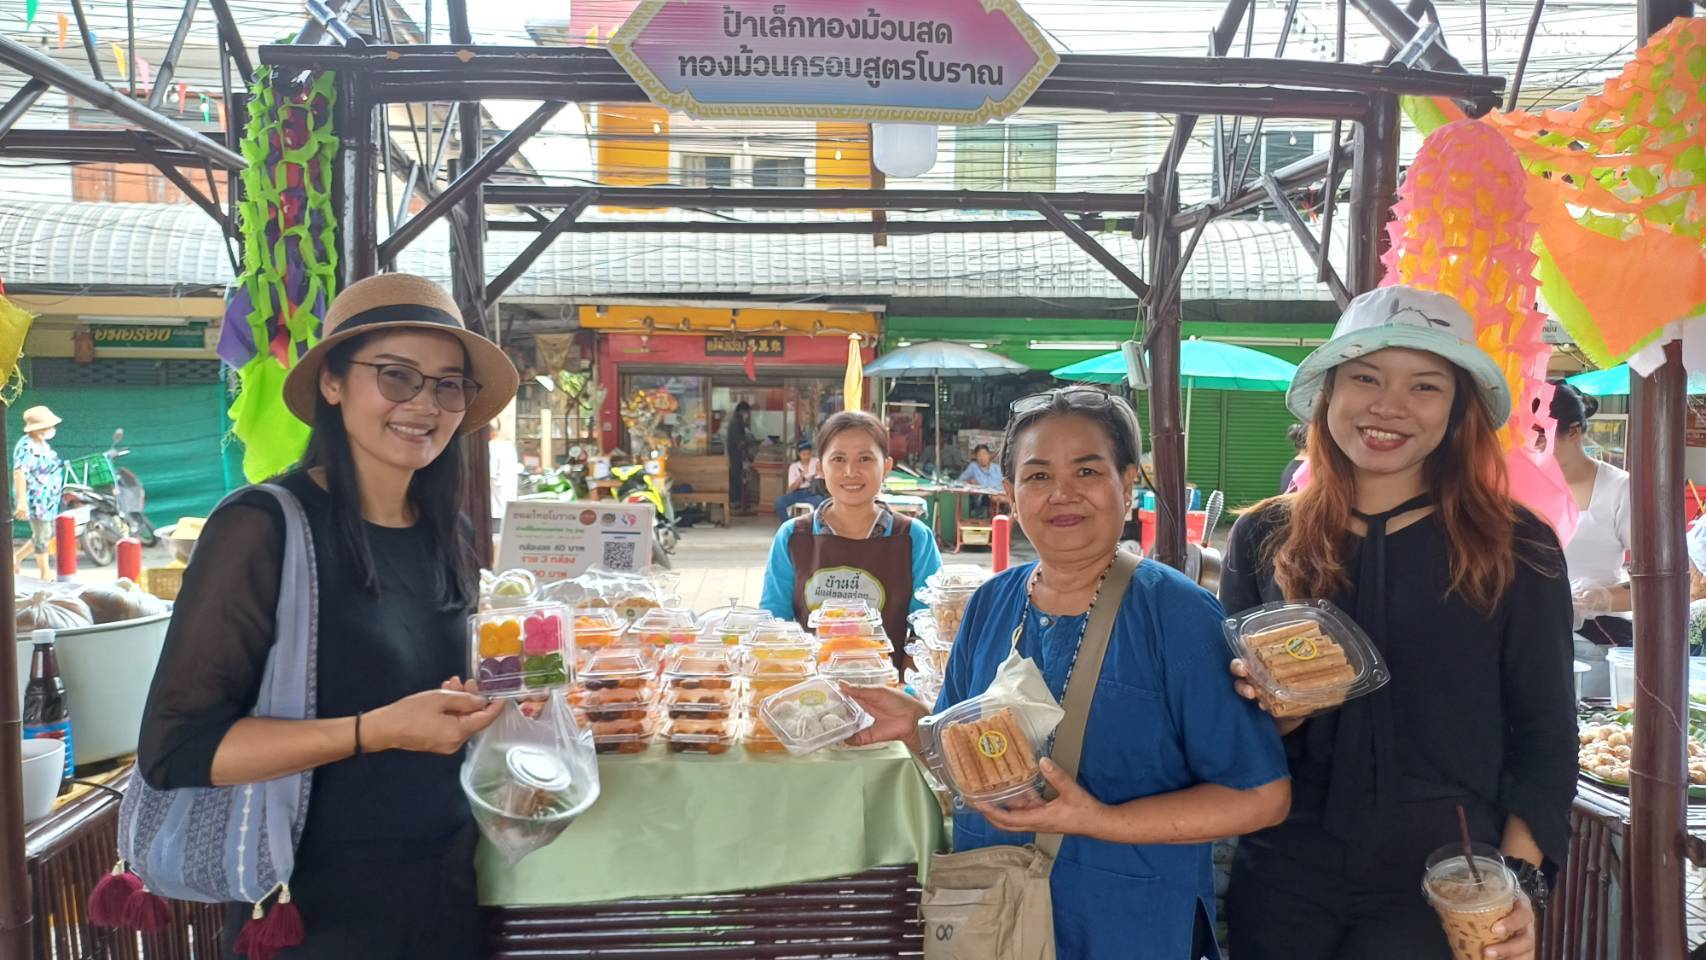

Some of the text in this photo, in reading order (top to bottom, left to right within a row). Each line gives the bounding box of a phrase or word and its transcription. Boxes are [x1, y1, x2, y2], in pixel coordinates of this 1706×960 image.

[723, 4, 953, 45] ป้าเล็กทองม้วนสด
[677, 45, 1004, 88] ทองม้วนกรอบสูตรโบราณ
[825, 572, 861, 590] บ้านนี้
